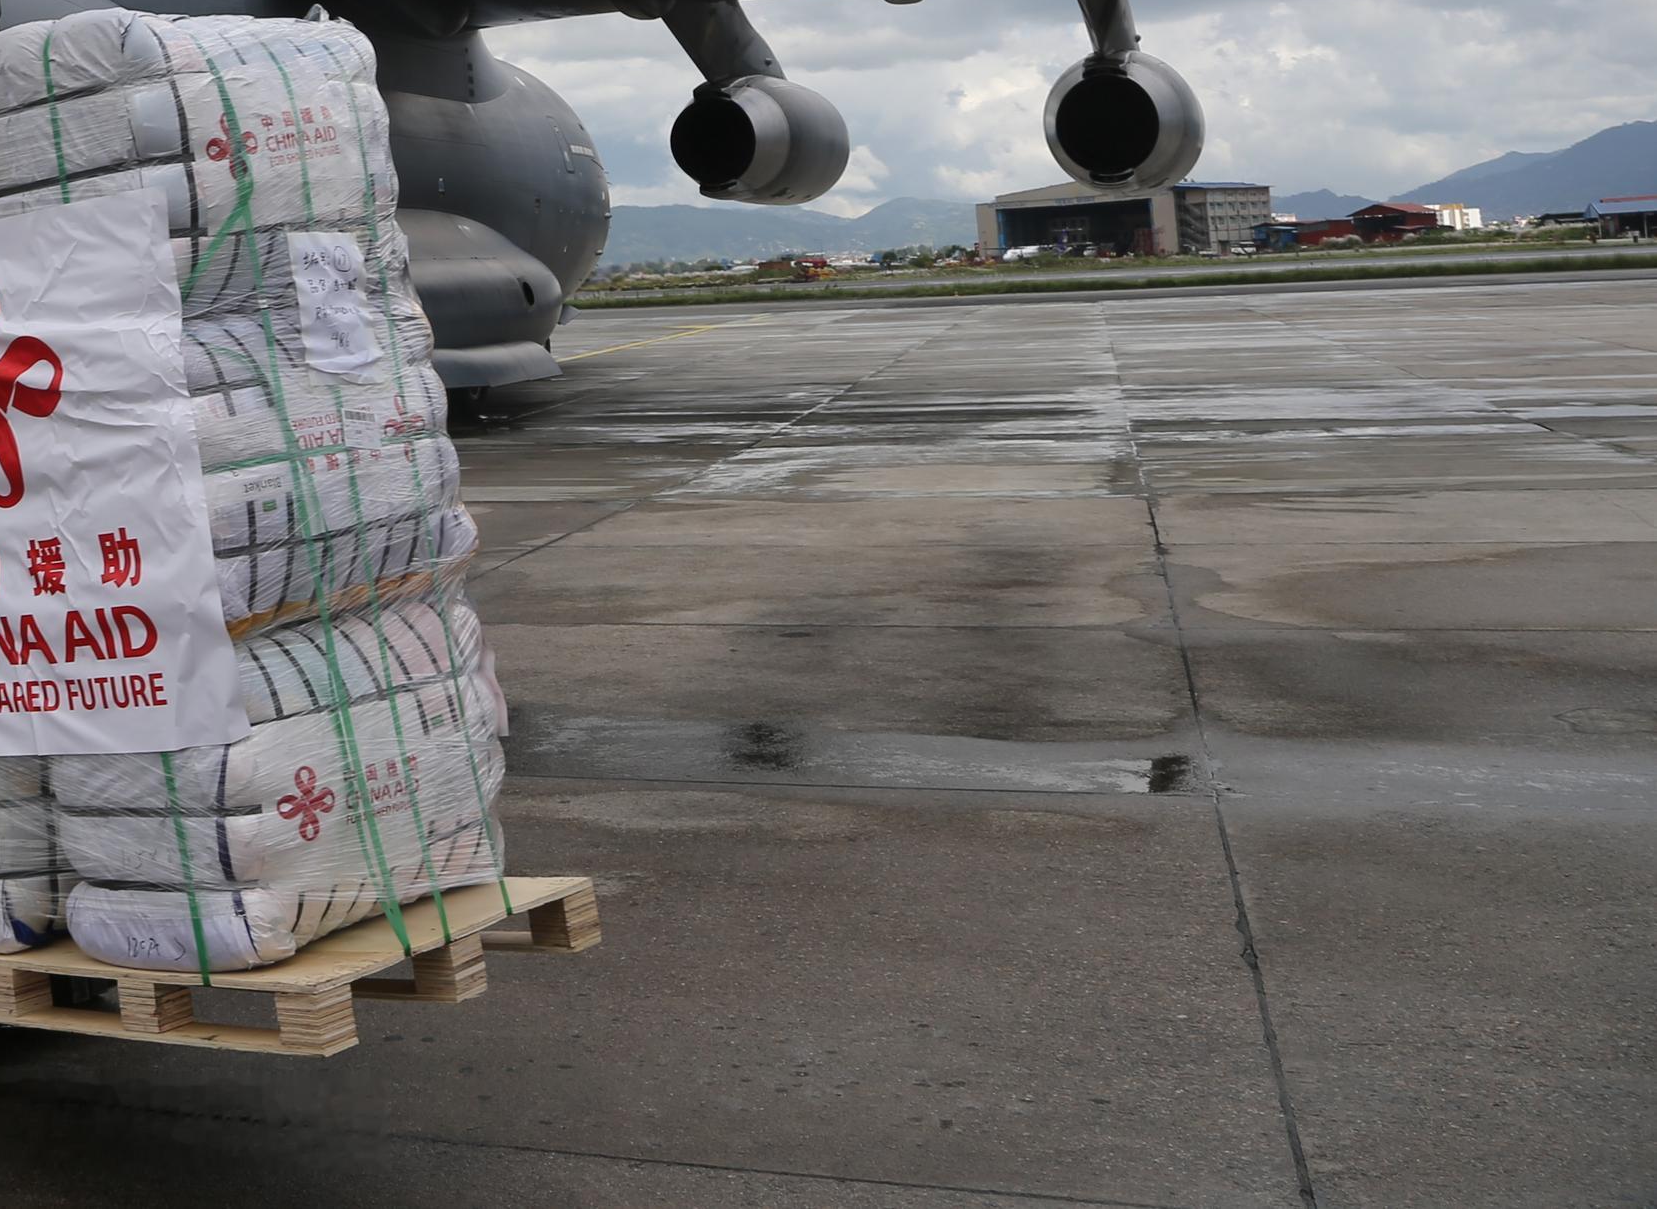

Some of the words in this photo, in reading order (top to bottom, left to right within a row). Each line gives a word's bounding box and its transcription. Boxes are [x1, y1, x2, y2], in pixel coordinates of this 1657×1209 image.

[315, 125, 337, 144] AID
[243, 477, 283, 495] Blanket
[65, 605, 159, 663] AID
[65, 672, 169, 711] FUTURE
[345, 784, 392, 810] CNA
